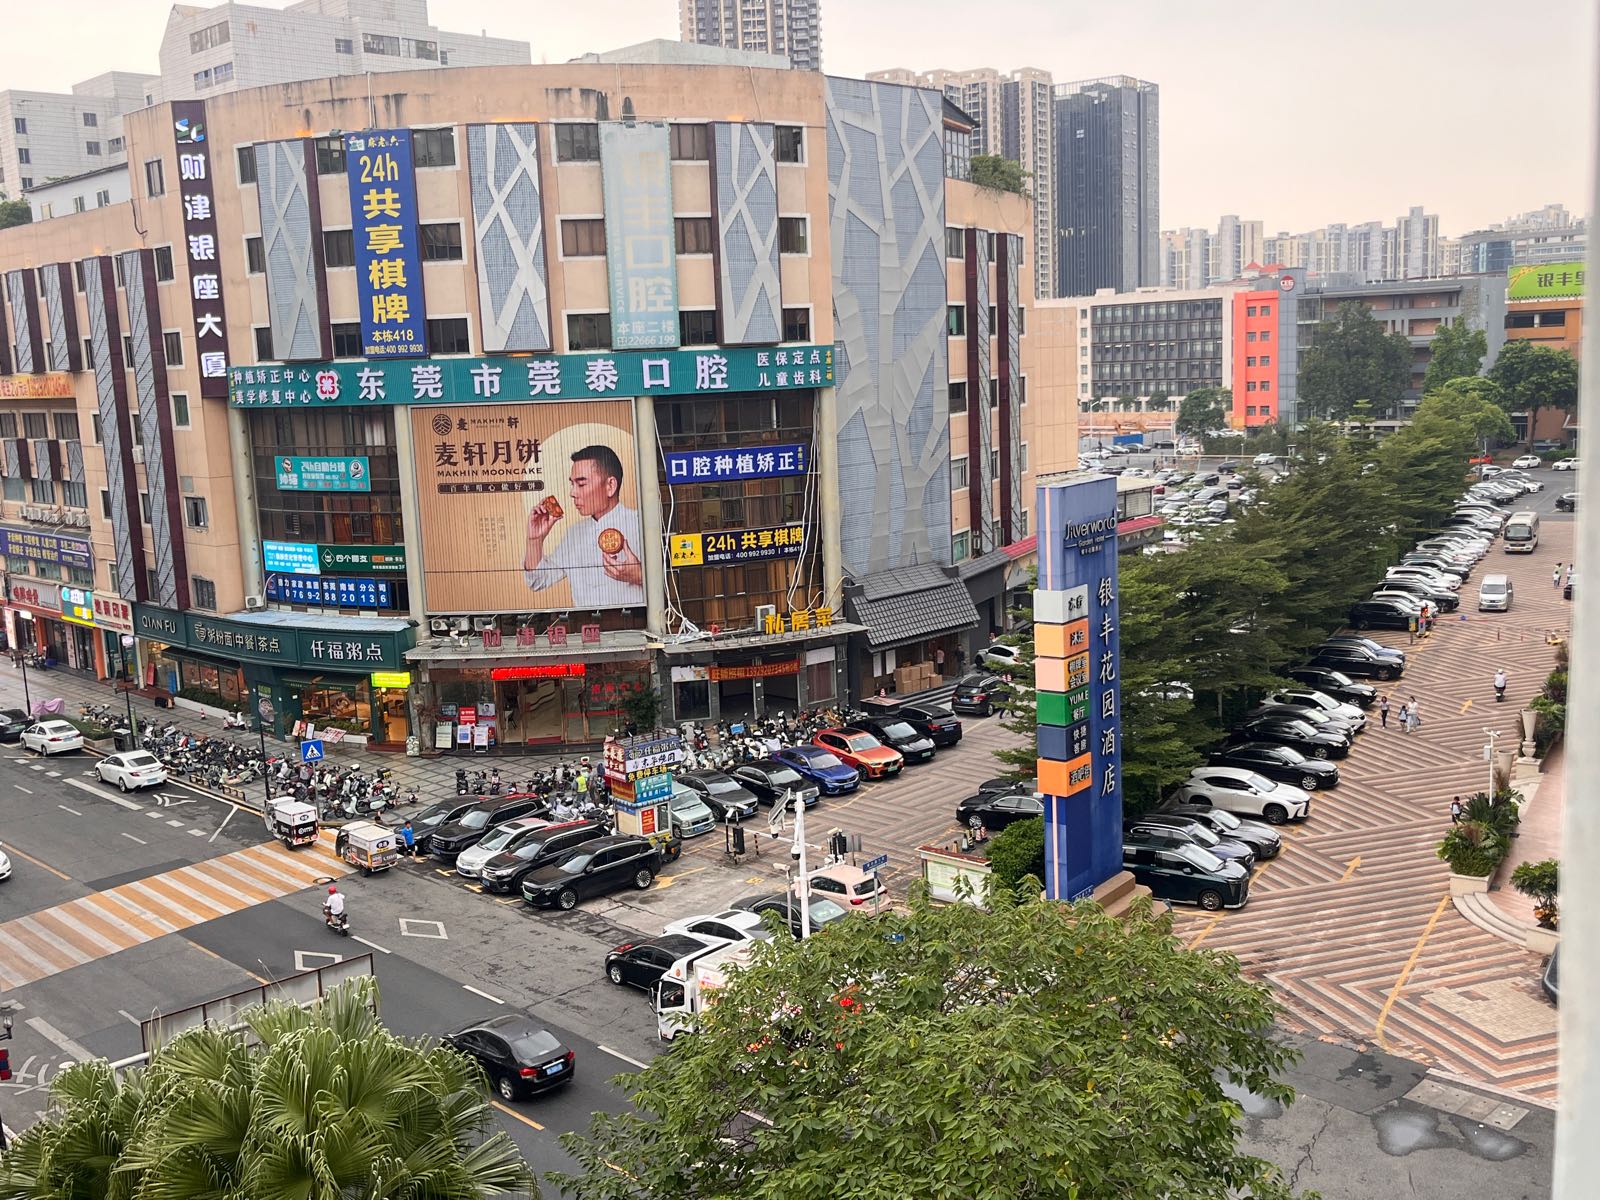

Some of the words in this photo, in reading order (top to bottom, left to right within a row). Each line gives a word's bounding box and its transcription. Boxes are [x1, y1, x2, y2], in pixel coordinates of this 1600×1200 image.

[360, 153, 399, 183] 24h
[180, 153, 228, 378] 财津银座大厦
[363, 188, 411, 324] 共享棋牌
[372, 329, 414, 343] 本栋418
[658, 334, 676, 346] 199
[398, 344, 408, 354] 992
[757, 349, 821, 367] 医保定点
[234, 369, 311, 385] 种植矫正中心
[356, 354, 730, 401] 东莞市莞泰口腔
[758, 369, 822, 387] 儿童齿科
[236, 389, 312, 405] 美学修复中心
[457, 418, 468, 431] 麦
[507, 416, 519, 429] 轩
[435, 439, 542, 467] 麦轩月饼
[482, 467, 543, 476] MOONCAKE
[671, 452, 795, 477] 口腔种植矫正
[707, 534, 736, 553] 24h
[741, 527, 804, 549] 共享棋牌
[765, 607, 833, 634] 私房菜
[483, 624, 600, 648] 财津银座
[310, 640, 384, 661] 仟福粥点
[1098, 577, 1116, 798] 银丰花园酒店
[627, 765, 667, 782] 免费停车场
